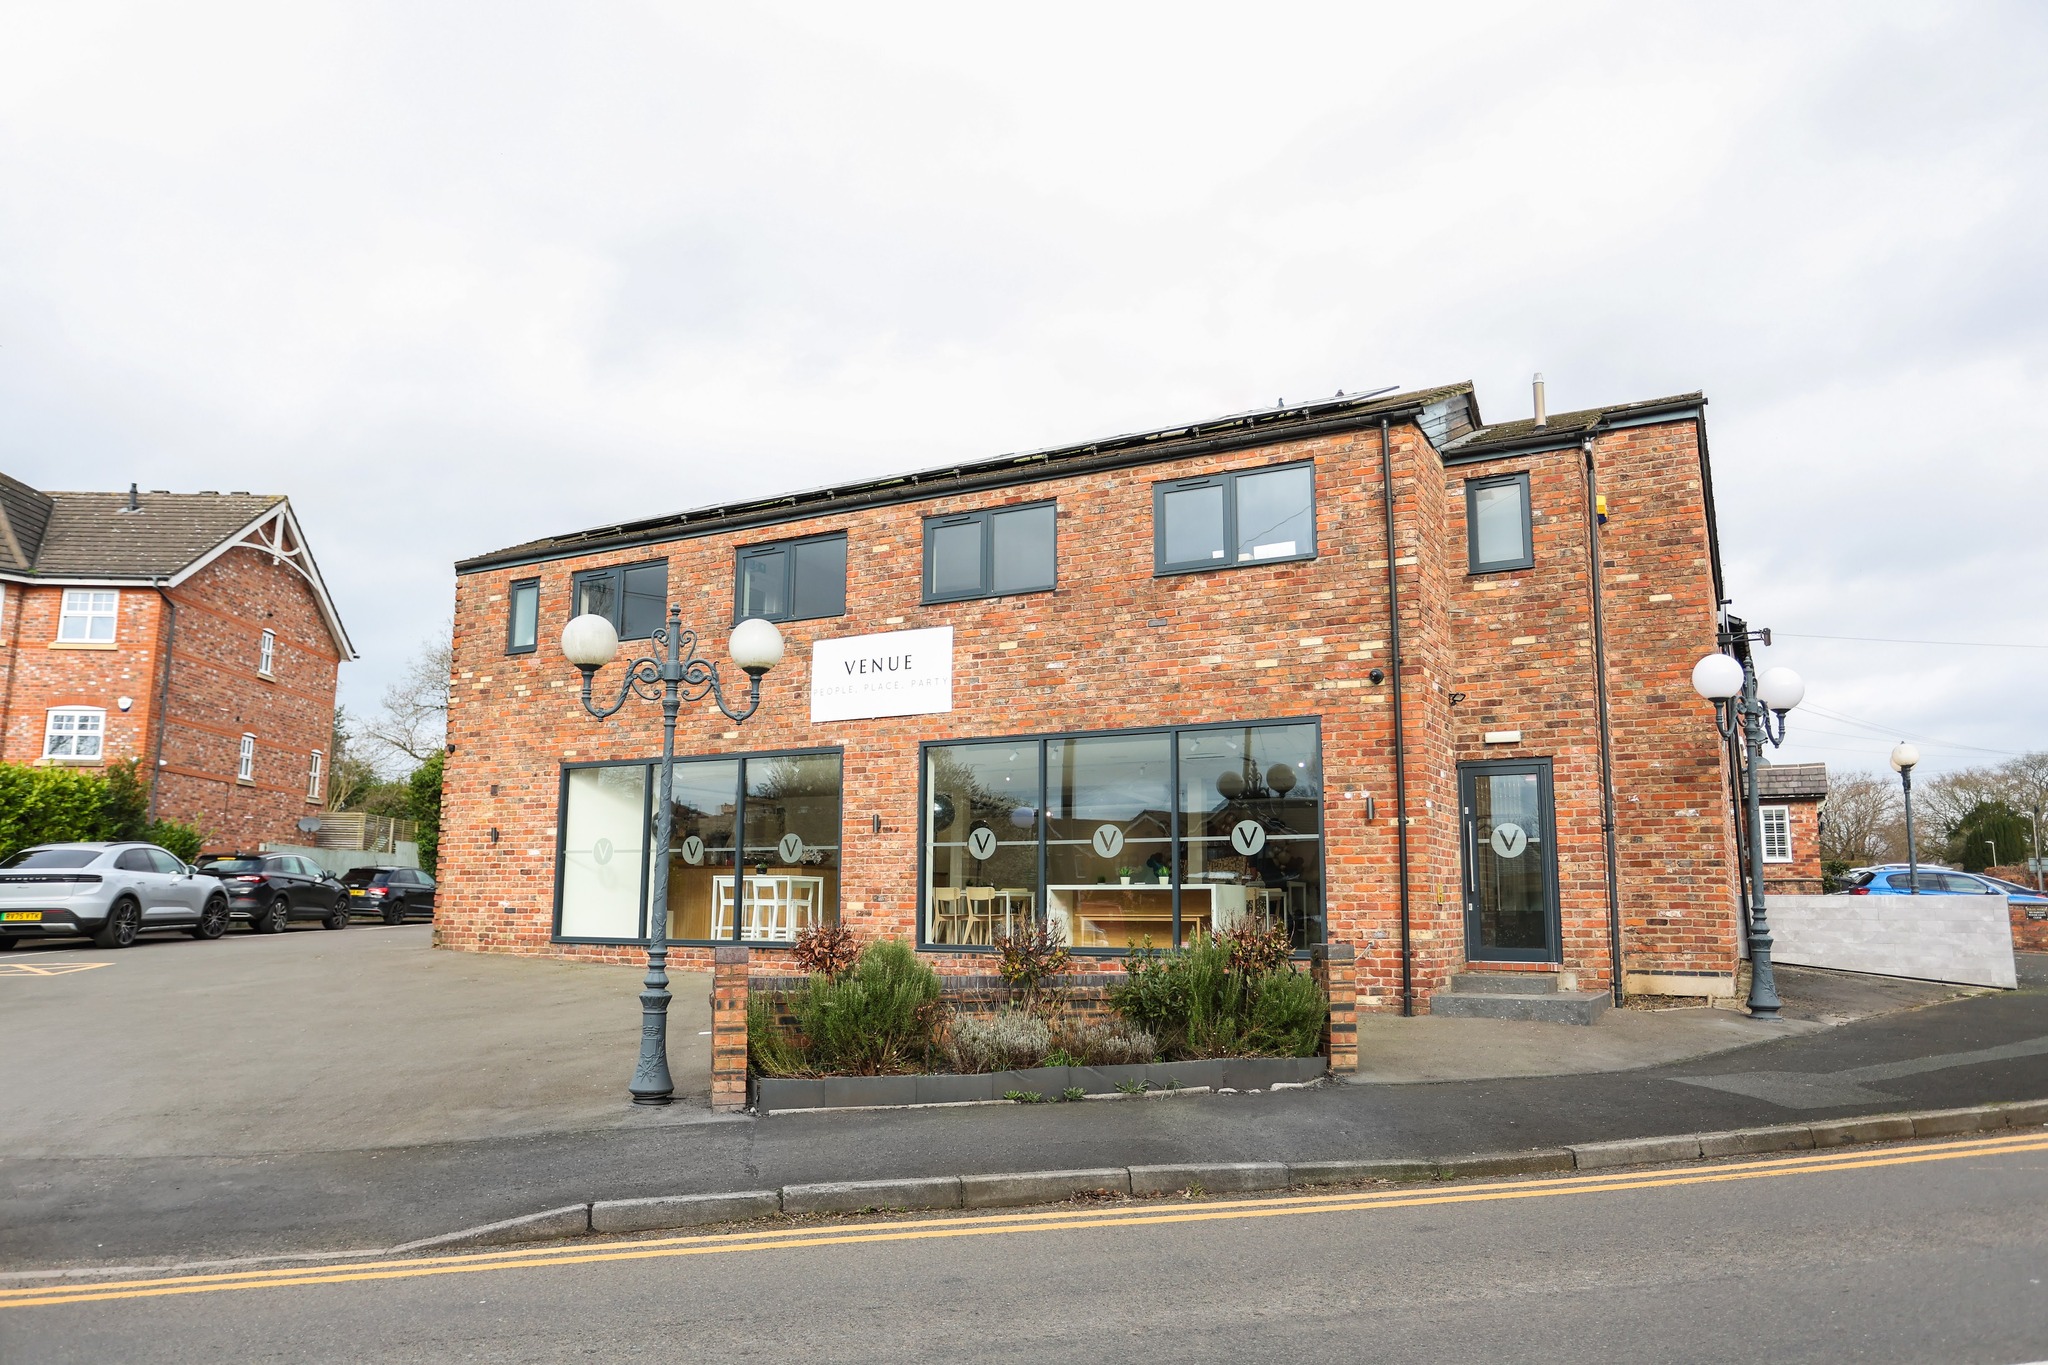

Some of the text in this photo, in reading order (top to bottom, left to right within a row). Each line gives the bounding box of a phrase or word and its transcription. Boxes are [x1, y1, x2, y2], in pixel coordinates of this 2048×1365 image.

[844, 654, 912, 676] VENUE
[813, 677, 948, 697] PEOPLE, PLACE, PARTY
[784, 838, 798, 858] V
[974, 833, 990, 854] V
[1099, 830, 1117, 852] V
[1238, 826, 1258, 849] V
[1498, 829, 1519, 852] V
[597, 843, 610, 860] V
[686, 841, 700, 859] V
